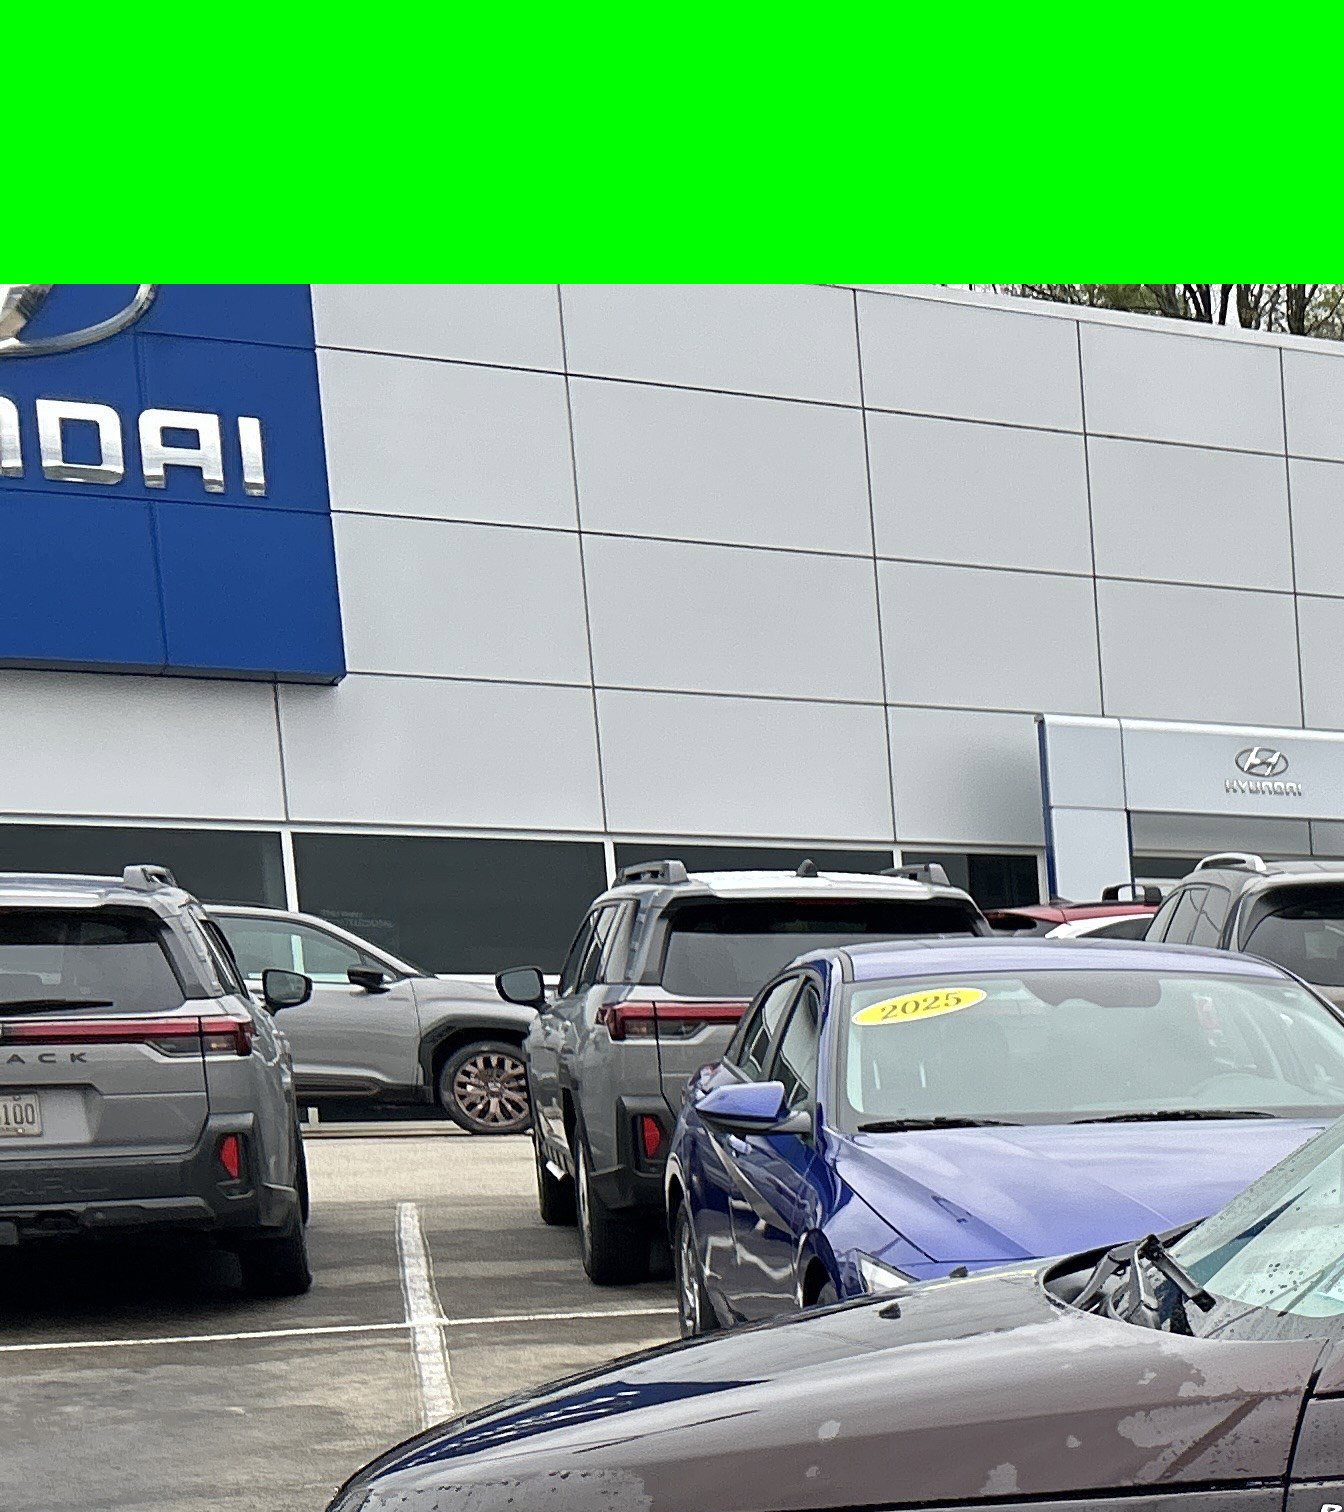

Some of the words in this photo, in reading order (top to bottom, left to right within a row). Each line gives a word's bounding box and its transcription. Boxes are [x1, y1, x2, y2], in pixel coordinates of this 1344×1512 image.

[0, 395, 267, 497] DAI
[1225, 779, 1302, 797] HYUNDAI
[881, 992, 962, 1021] 2025
